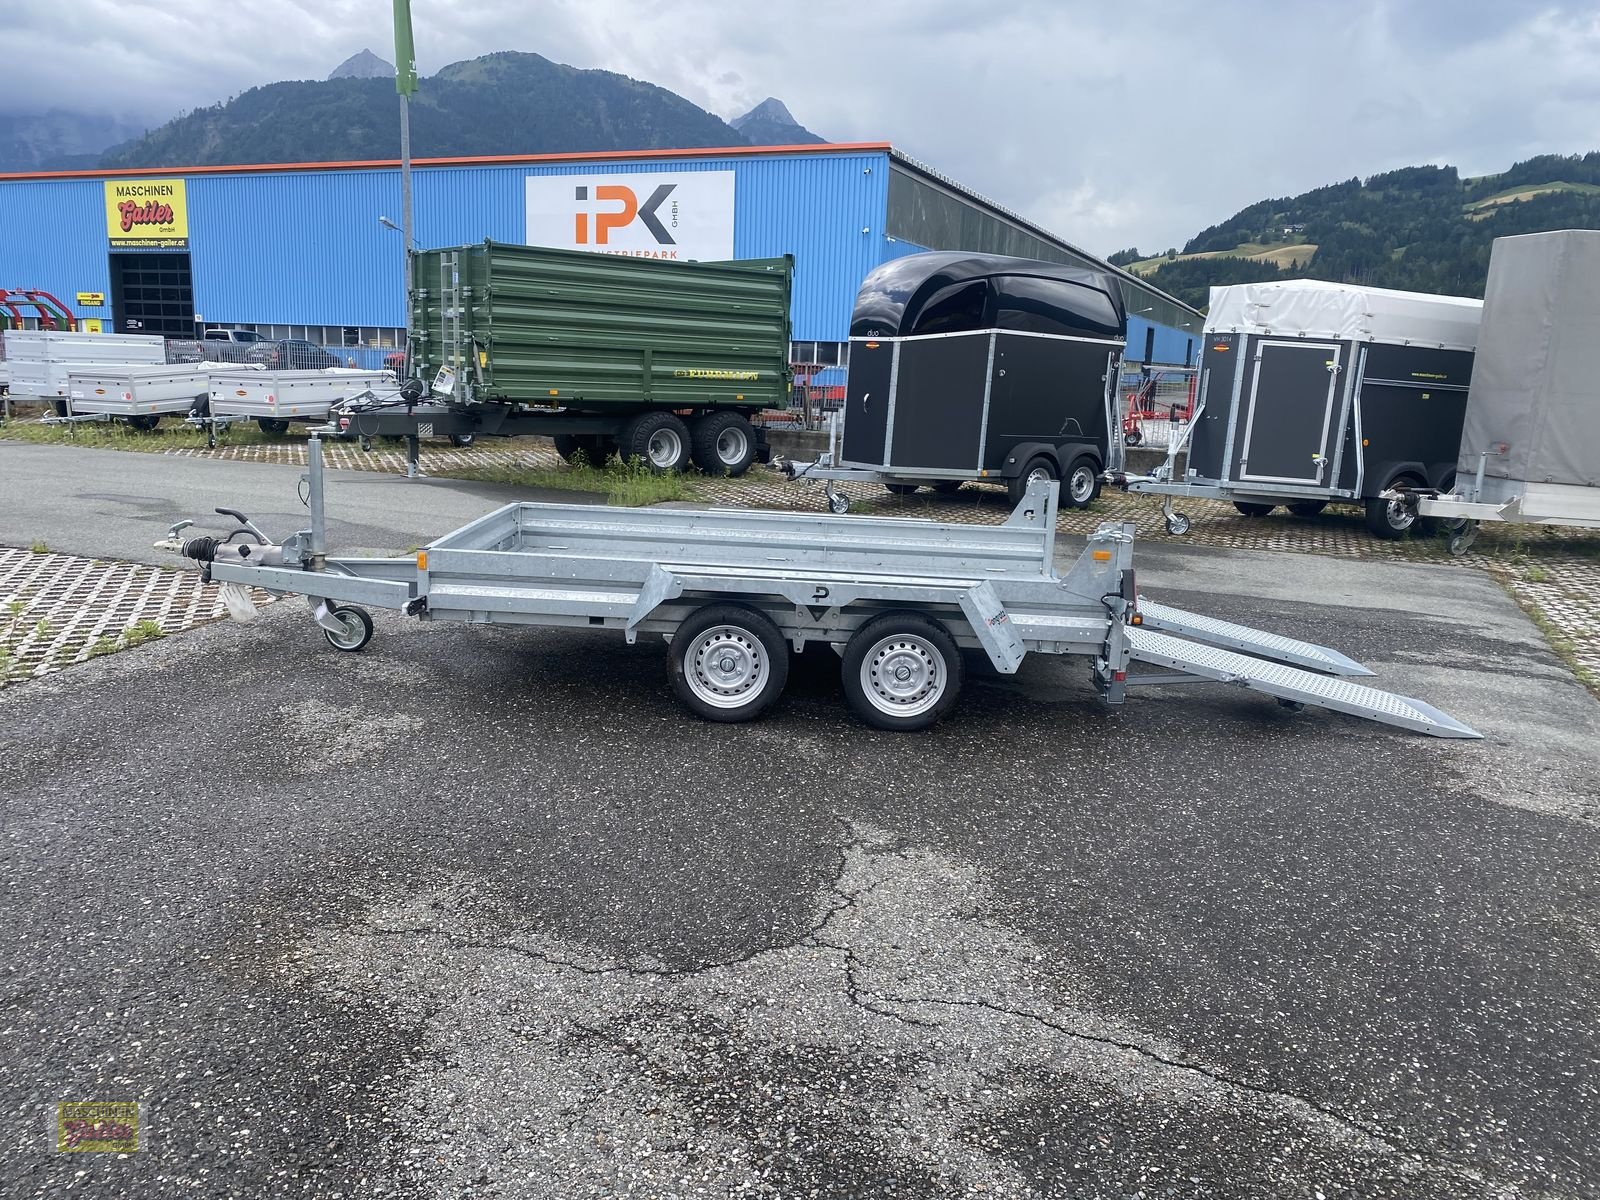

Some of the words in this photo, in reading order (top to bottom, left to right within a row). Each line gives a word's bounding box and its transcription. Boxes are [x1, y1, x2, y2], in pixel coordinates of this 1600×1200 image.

[116, 185, 173, 197] MASCHINEN
[117, 199, 174, 233] Gailer
[671, 200, 679, 228] GMBH
[867, 329, 880, 337] duo
